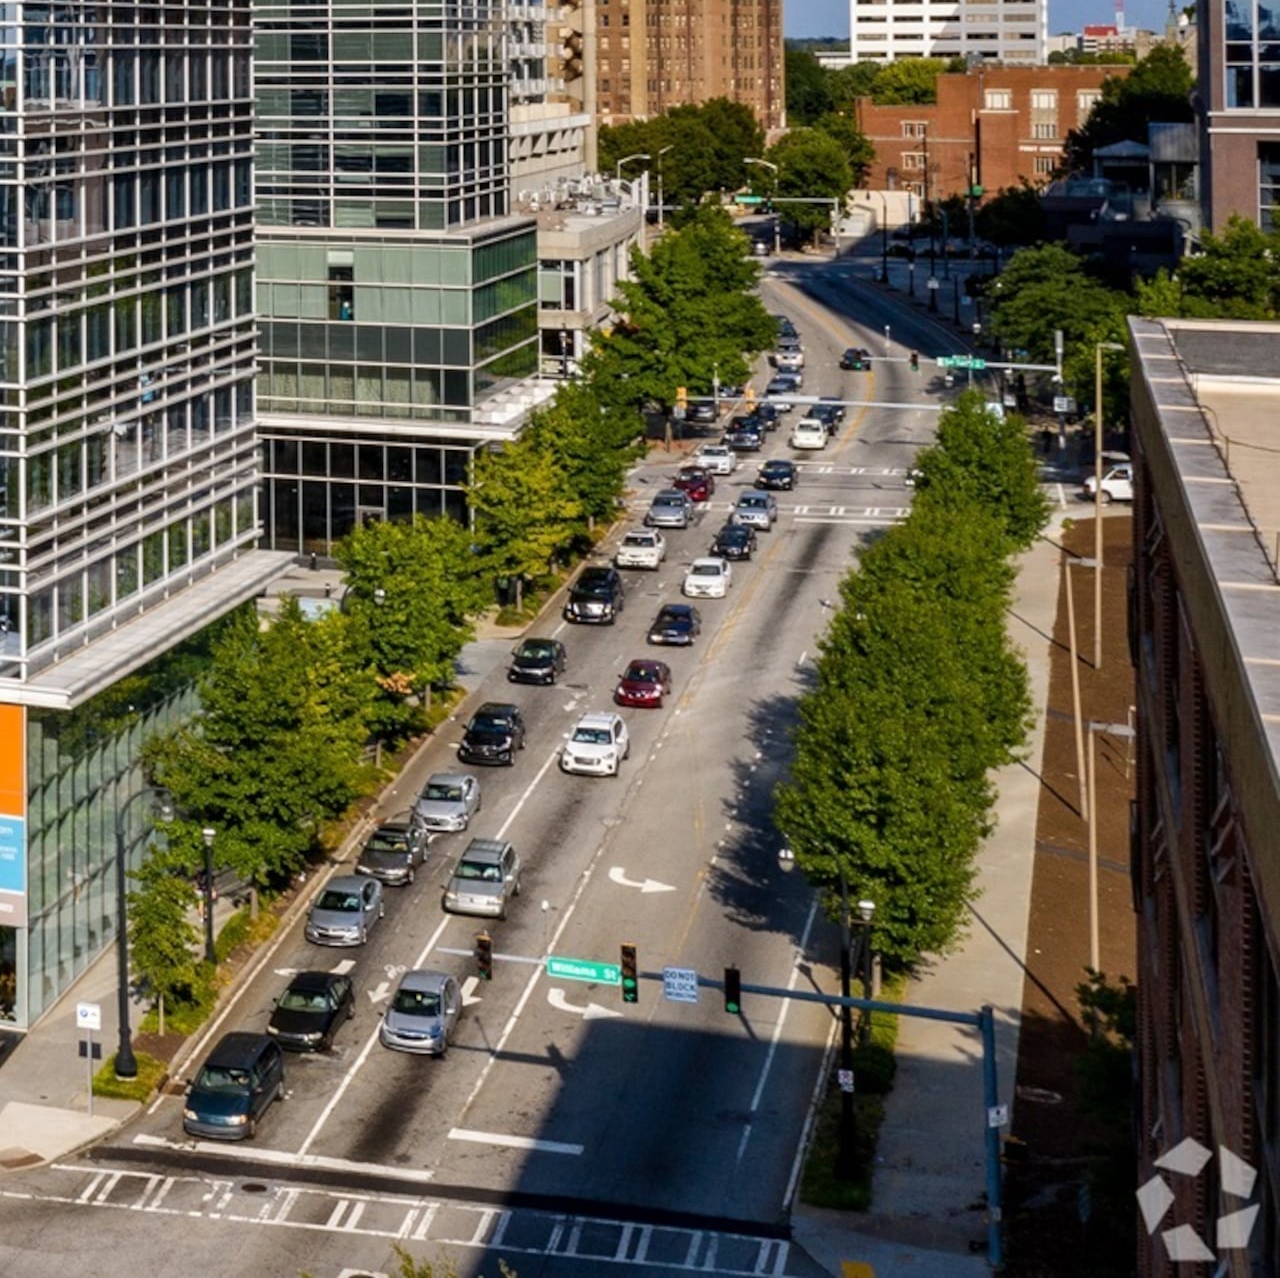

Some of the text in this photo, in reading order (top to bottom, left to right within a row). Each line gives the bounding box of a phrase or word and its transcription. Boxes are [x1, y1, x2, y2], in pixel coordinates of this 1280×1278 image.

[551, 962, 617, 981] Williams St
[664, 970, 695, 982] DO NOT
[665, 982, 696, 991] BLOCK
